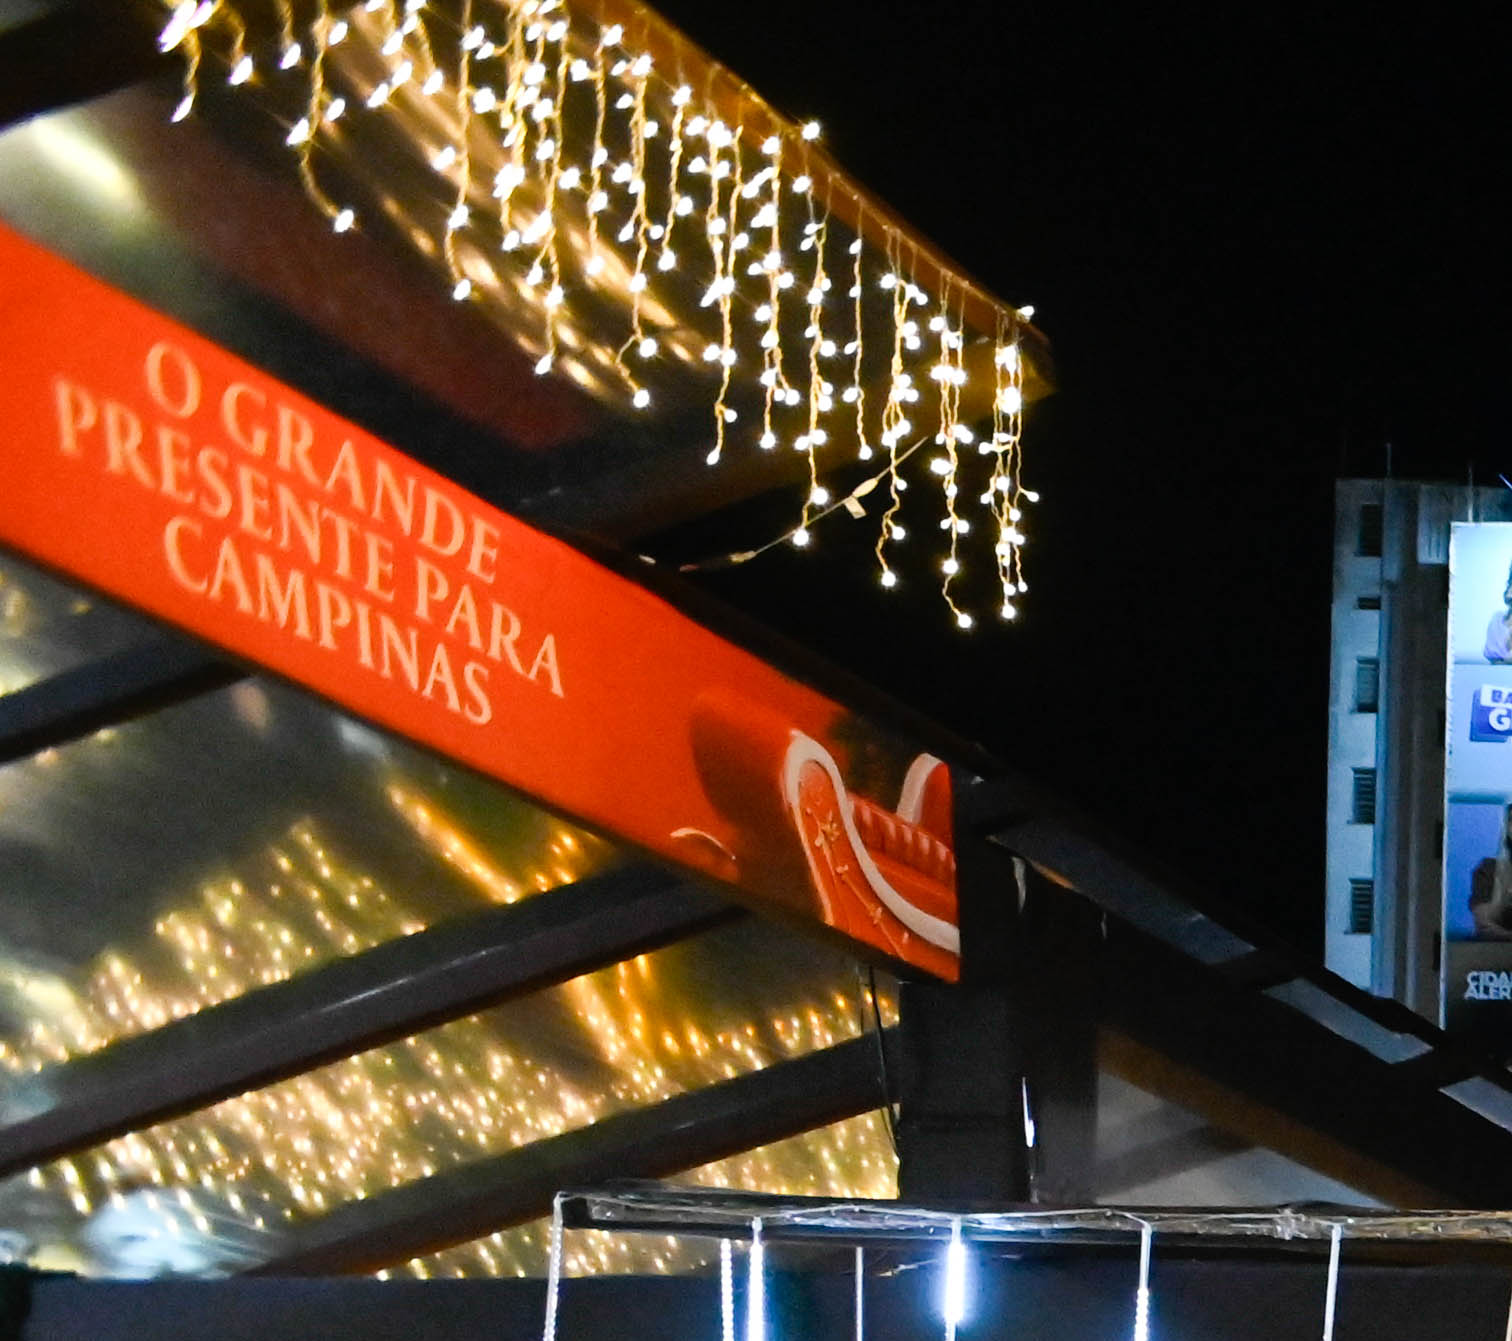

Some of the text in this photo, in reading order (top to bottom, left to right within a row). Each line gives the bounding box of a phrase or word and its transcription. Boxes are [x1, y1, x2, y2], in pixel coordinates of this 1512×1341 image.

[53, 376, 565, 698] PRESENTE PARA
[144, 341, 500, 584] O GRANDE
[163, 516, 493, 725] CAMPINAS
